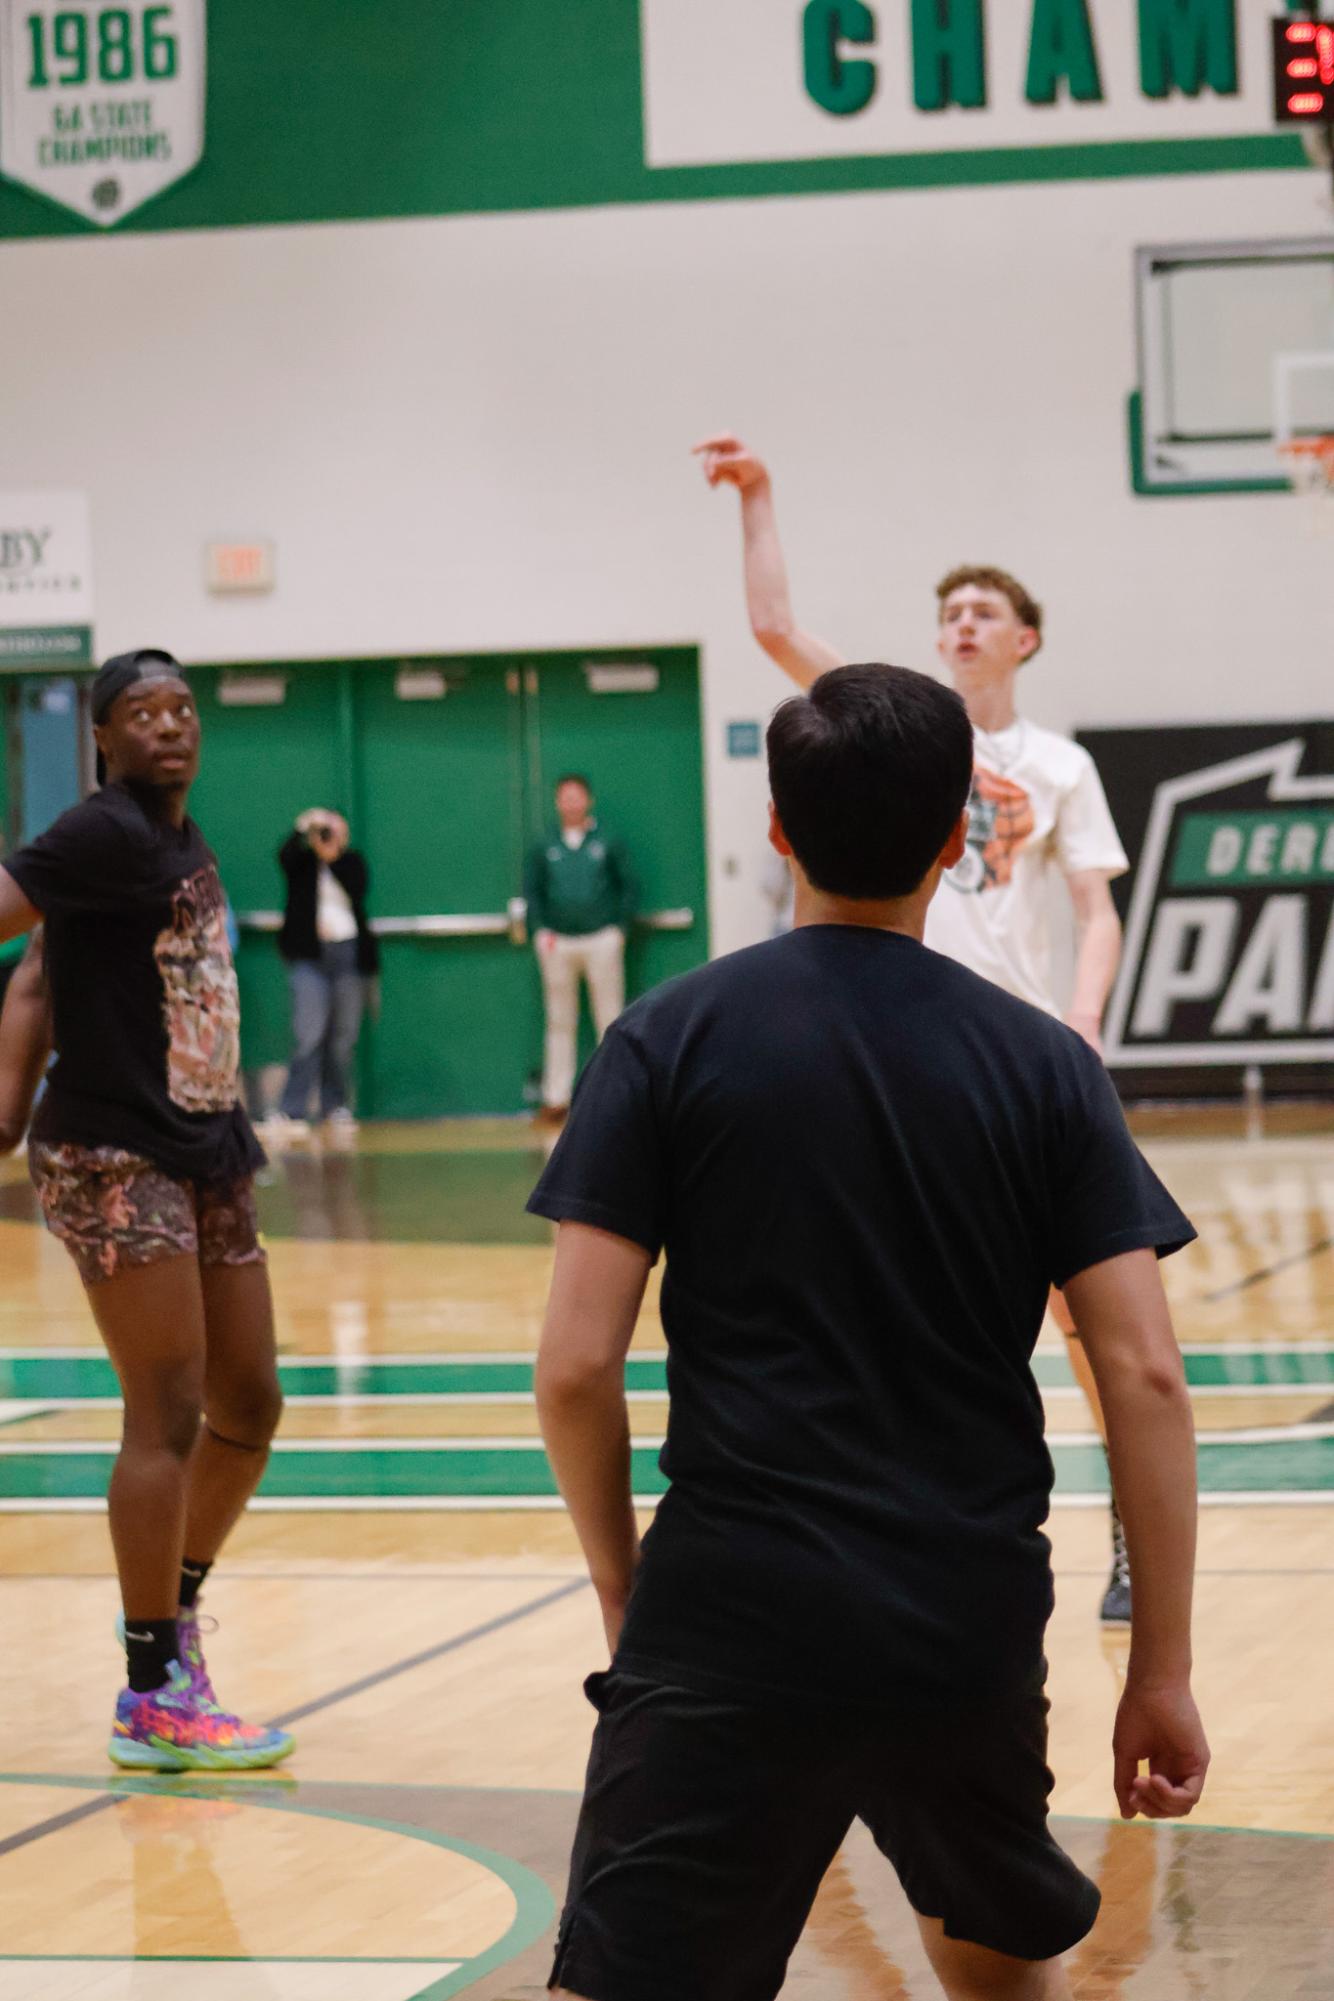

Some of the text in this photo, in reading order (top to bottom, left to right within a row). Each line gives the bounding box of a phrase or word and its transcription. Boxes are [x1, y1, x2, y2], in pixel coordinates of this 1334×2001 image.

[26, 6, 178, 89] 1986
[802, 0, 1319, 116] CHAM
[37, 132, 172, 168] CHAMPIONS
